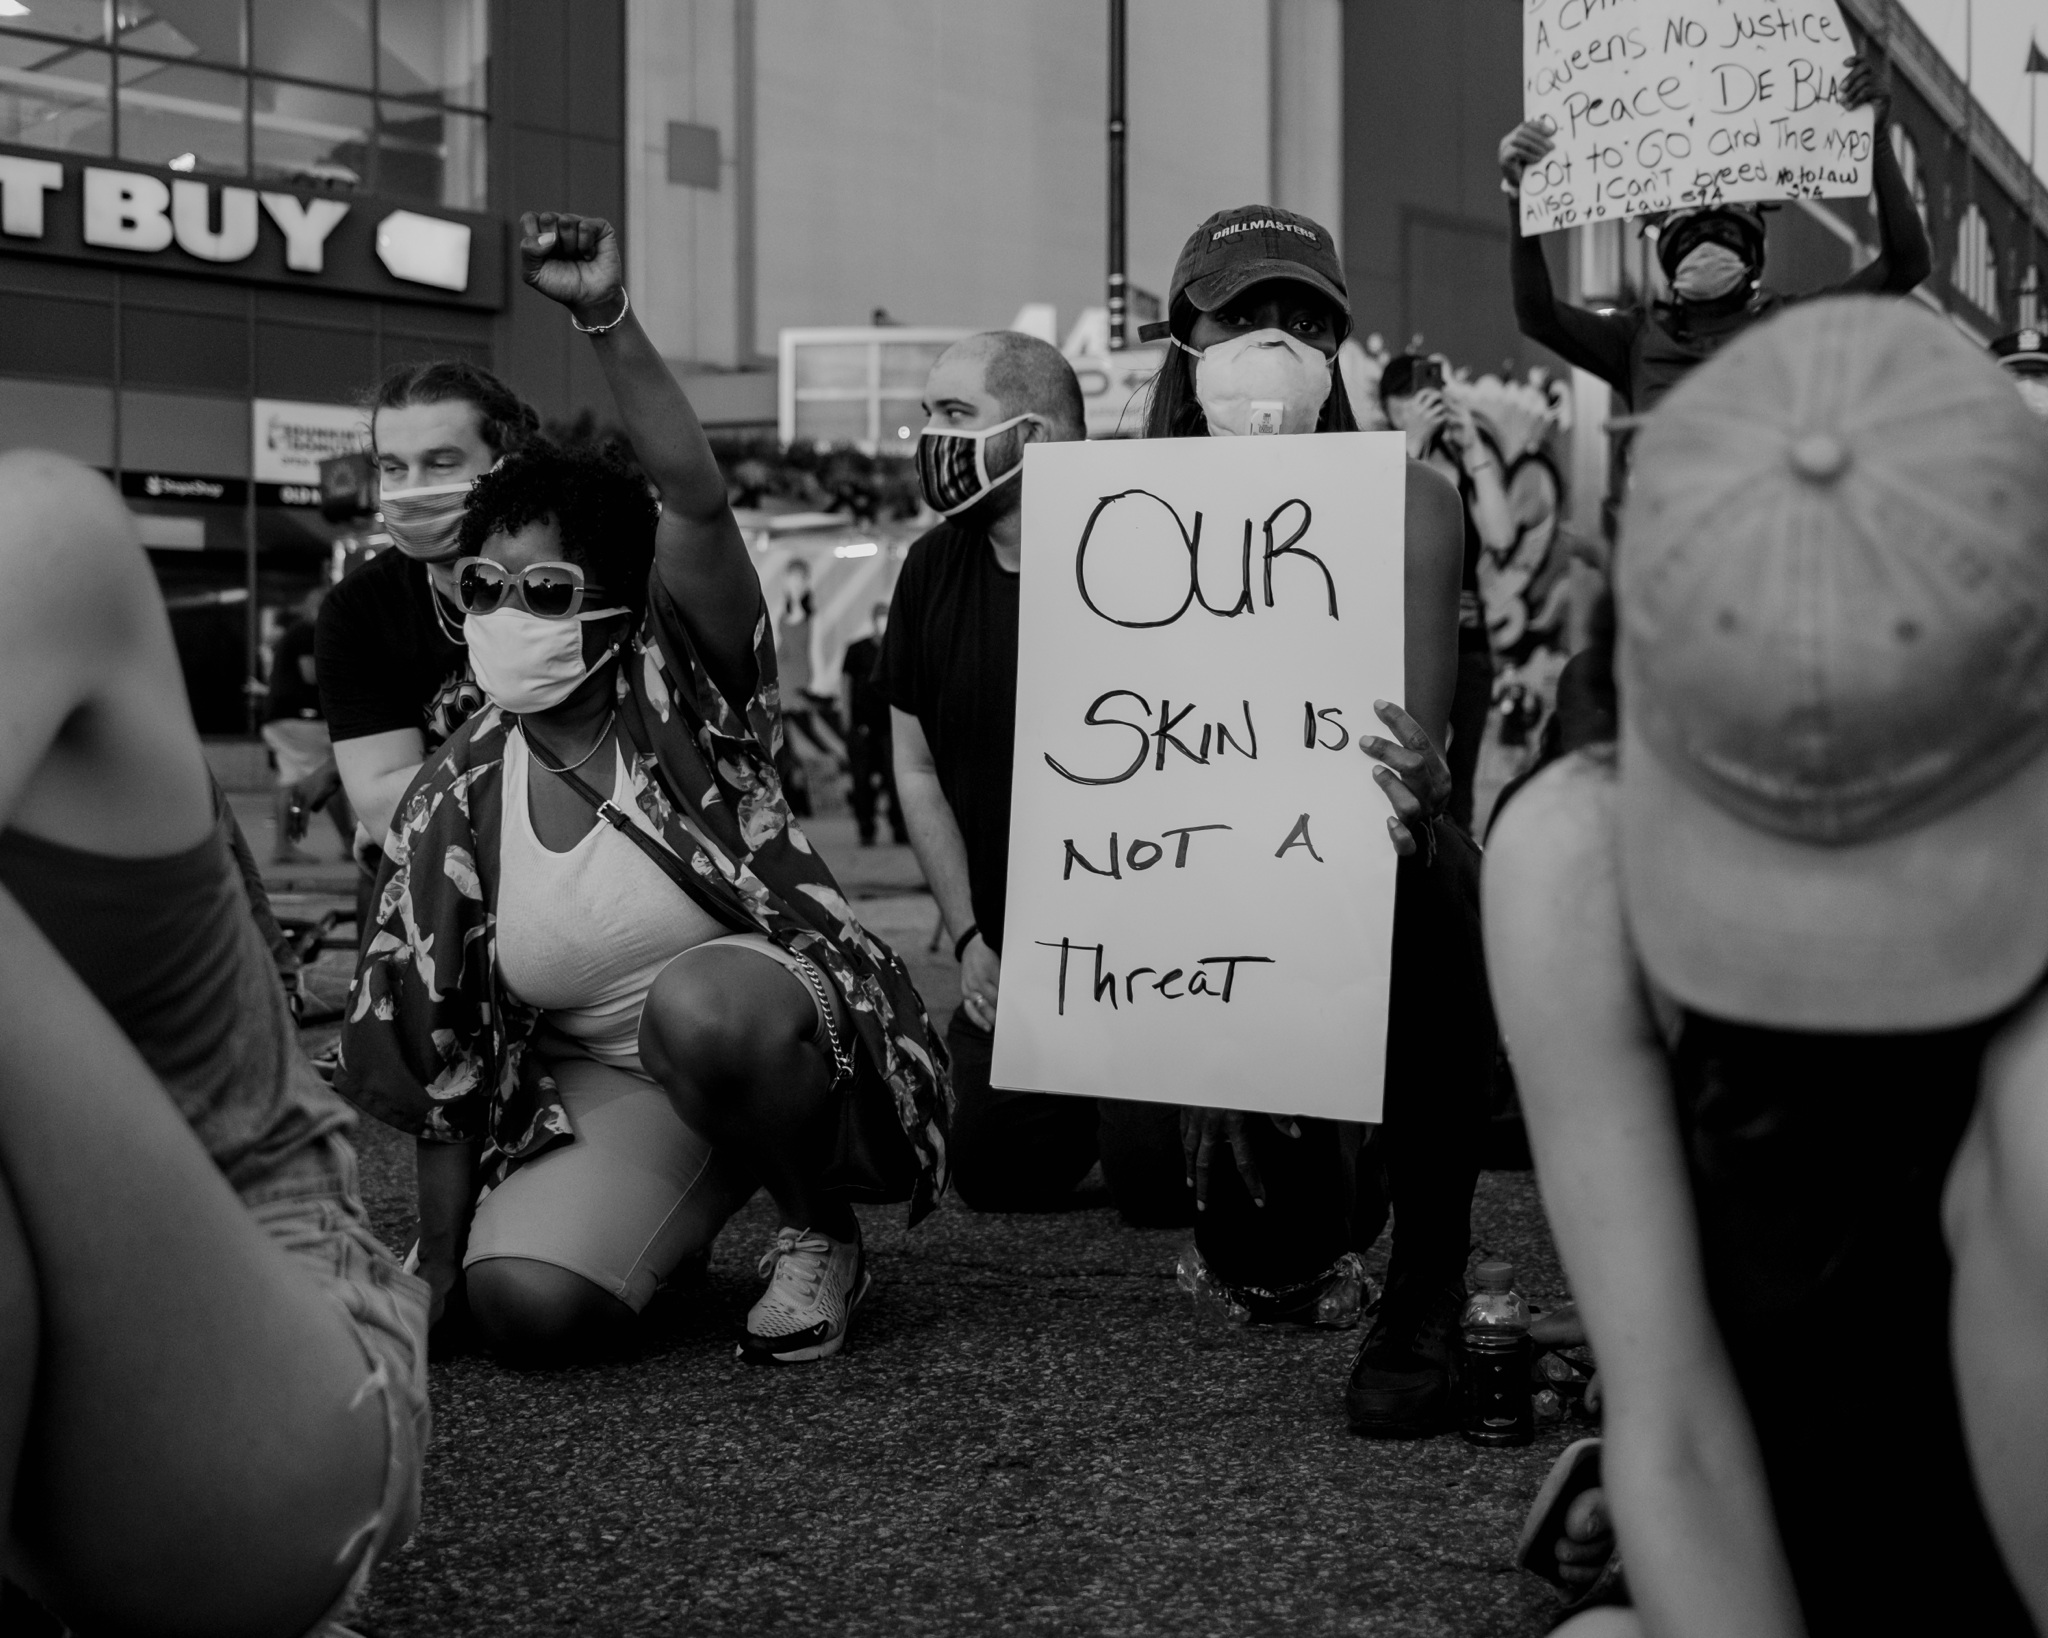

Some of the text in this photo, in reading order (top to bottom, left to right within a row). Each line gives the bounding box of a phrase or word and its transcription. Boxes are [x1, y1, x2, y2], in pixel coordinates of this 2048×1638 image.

[1586, 143, 1623, 174] to
[83, 165, 351, 274] BUY
[1211, 218, 1318, 242] DRILLMASTERS
[1075, 488, 1339, 629] OUR
[1043, 689, 1350, 786] SKIN IS
[1063, 812, 1325, 880] NOT A
